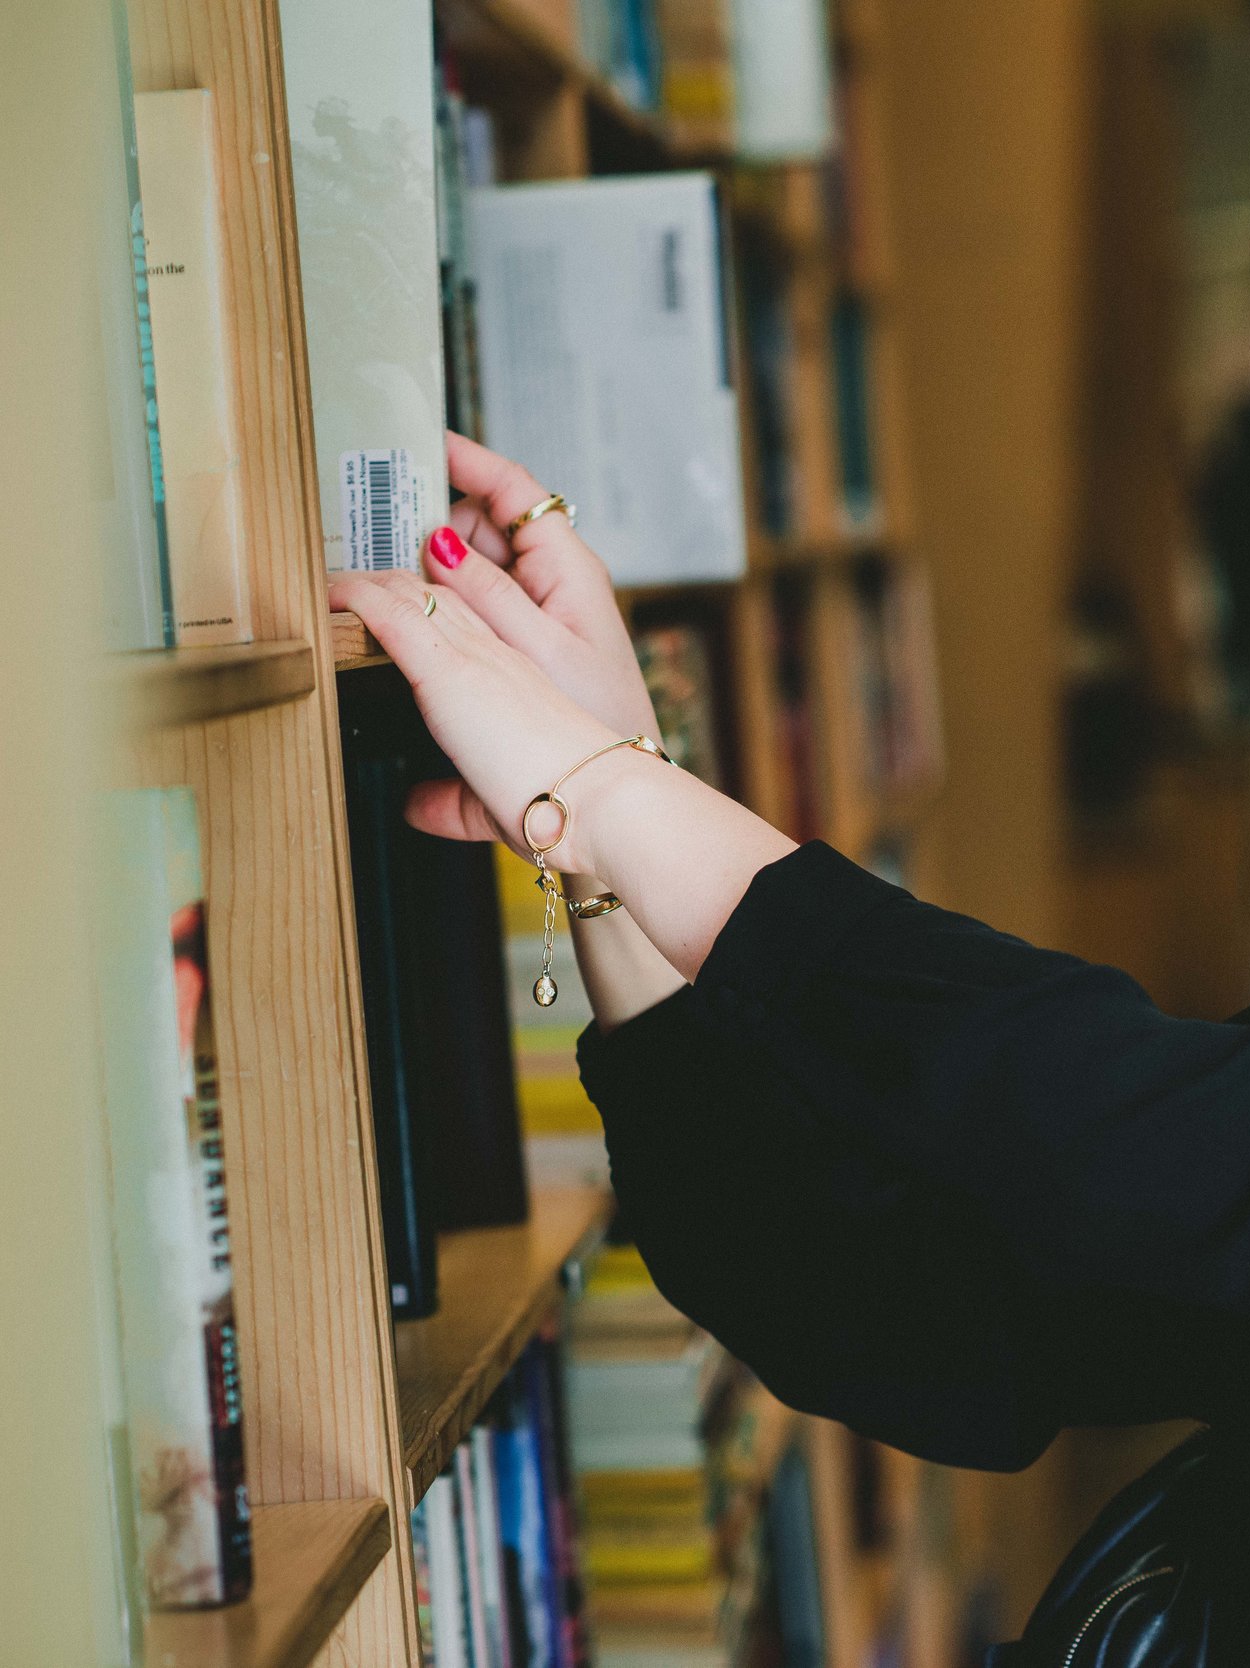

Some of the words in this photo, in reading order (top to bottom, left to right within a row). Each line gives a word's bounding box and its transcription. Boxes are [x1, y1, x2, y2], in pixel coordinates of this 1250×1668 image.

[166, 262, 185, 274] the
[346, 460, 355, 485] $6.95
[349, 508, 357, 544] Powell's
[361, 529, 369, 541] Do
[361, 543, 369, 557] We
